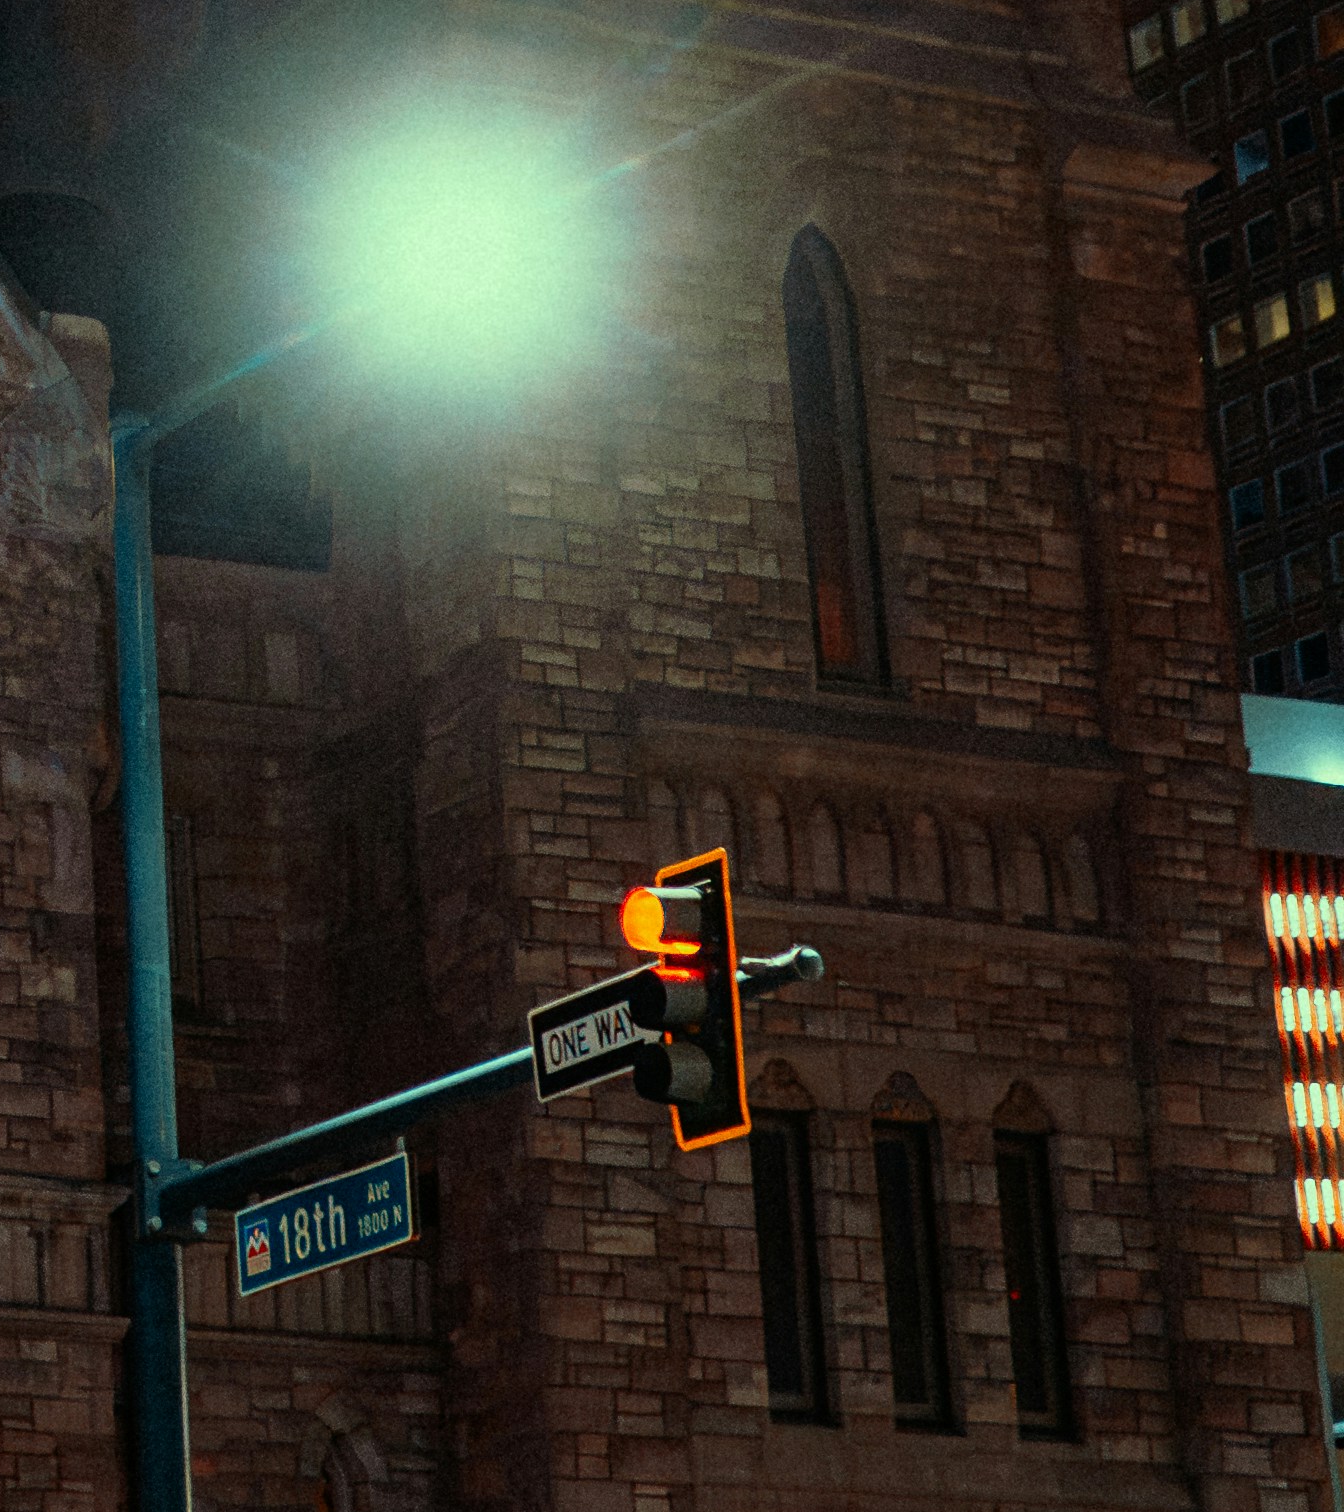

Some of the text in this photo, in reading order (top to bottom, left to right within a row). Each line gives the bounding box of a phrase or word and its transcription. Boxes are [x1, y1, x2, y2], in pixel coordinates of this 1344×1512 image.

[549, 1007, 635, 1066] ONE WAY
[367, 1180, 390, 1204] Ave
[279, 1194, 347, 1265] 18th
[357, 1204, 402, 1238] 1800 N
